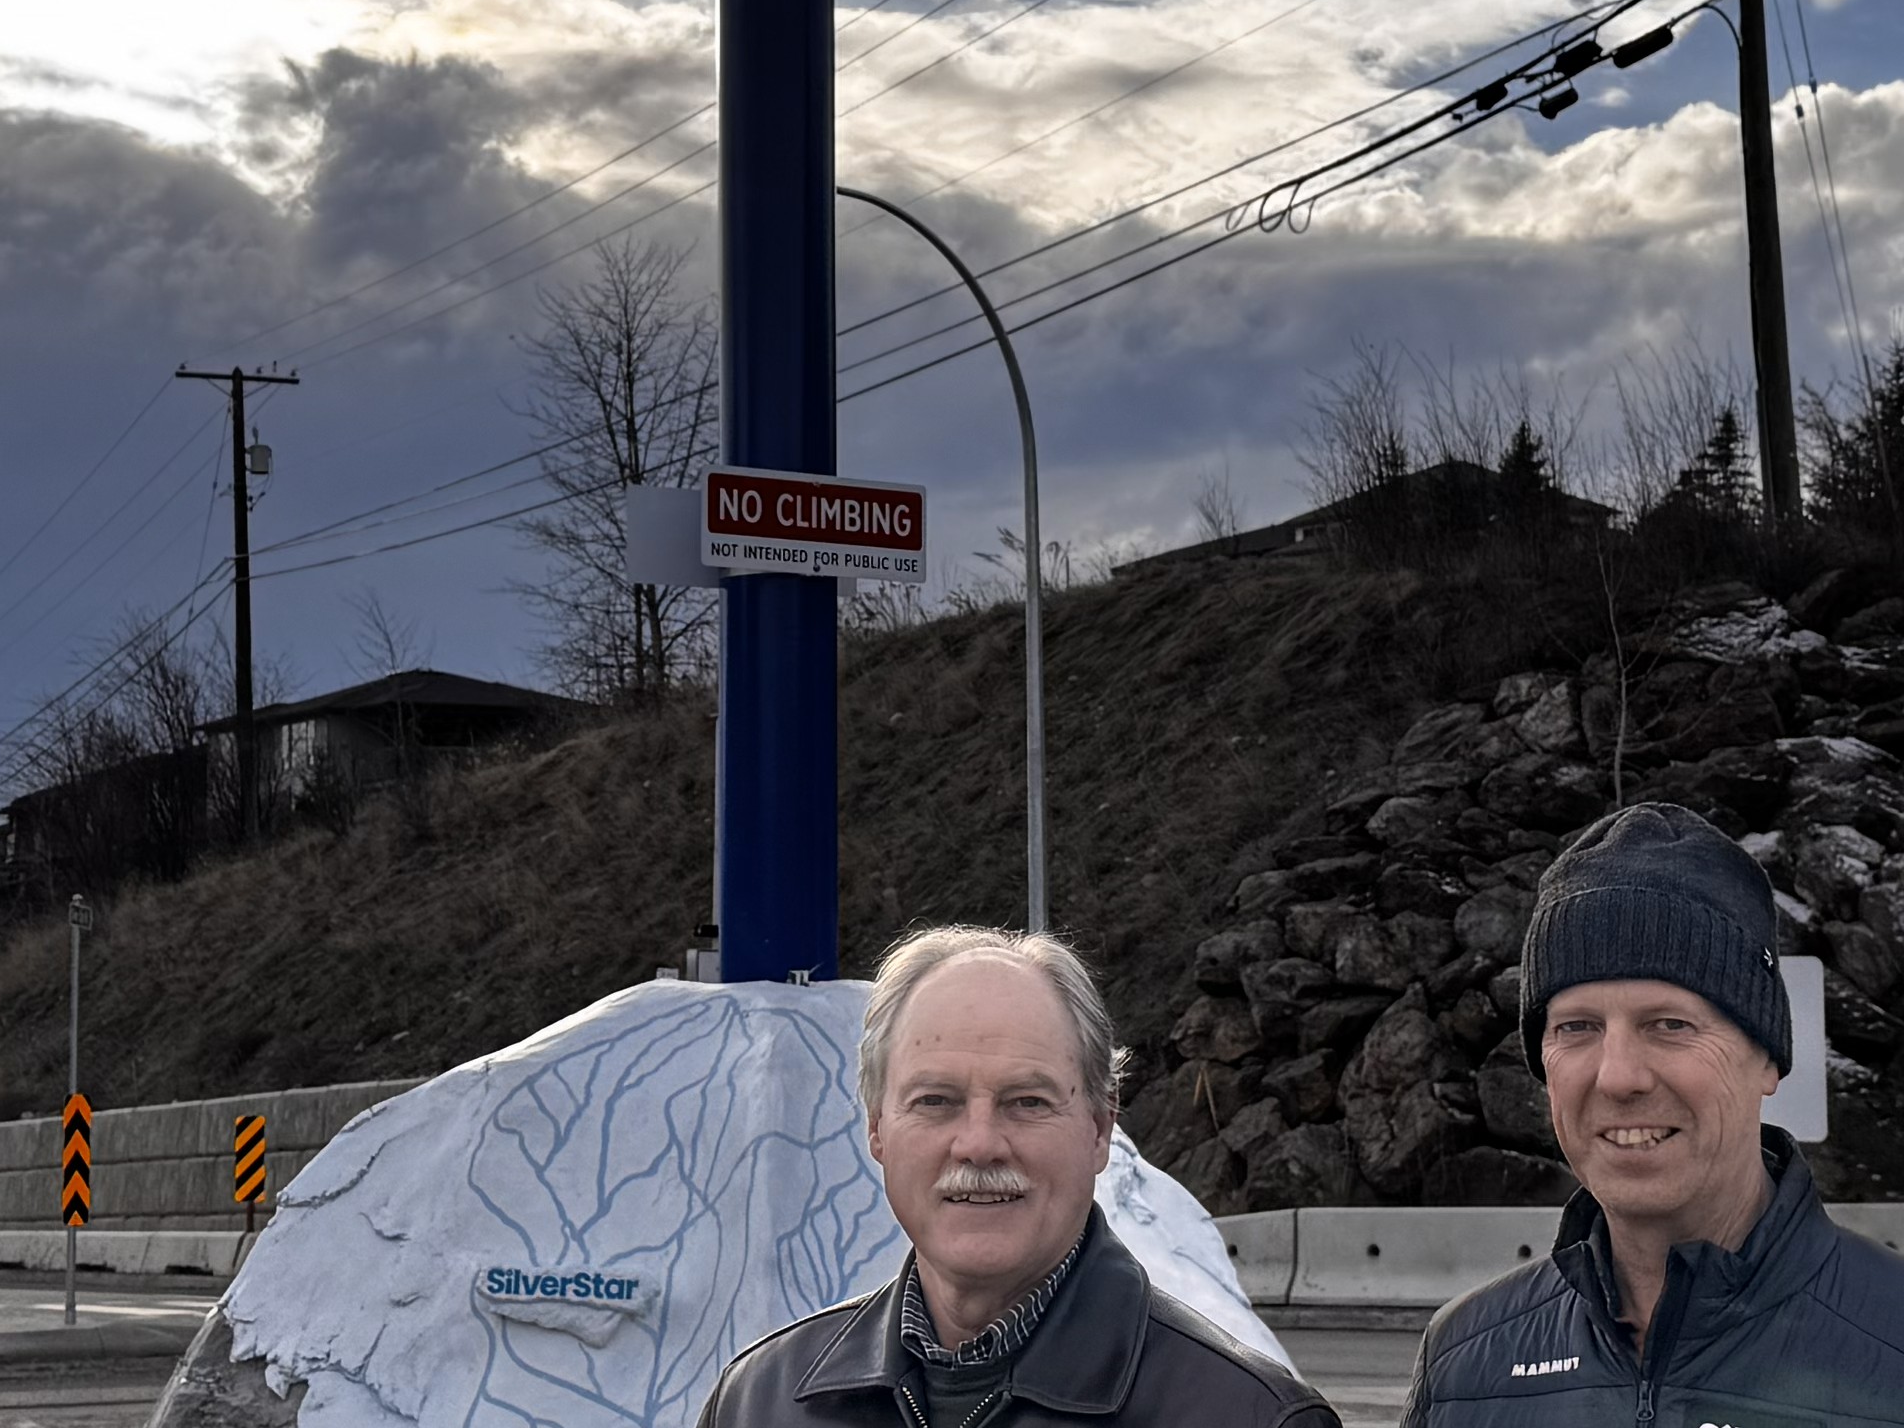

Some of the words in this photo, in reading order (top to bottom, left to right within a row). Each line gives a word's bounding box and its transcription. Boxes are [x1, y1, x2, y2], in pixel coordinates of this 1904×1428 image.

[719, 487, 762, 523] NO
[776, 492, 912, 537] CLIMBING
[711, 542, 738, 558] NOT
[744, 544, 808, 563] INTENDED
[813, 550, 839, 566] FOR
[845, 553, 889, 570] PUBLIC
[895, 558, 919, 573] USE
[487, 1267, 639, 1300] SilverStar
[1512, 1356, 1580, 1376] MAMMUT
